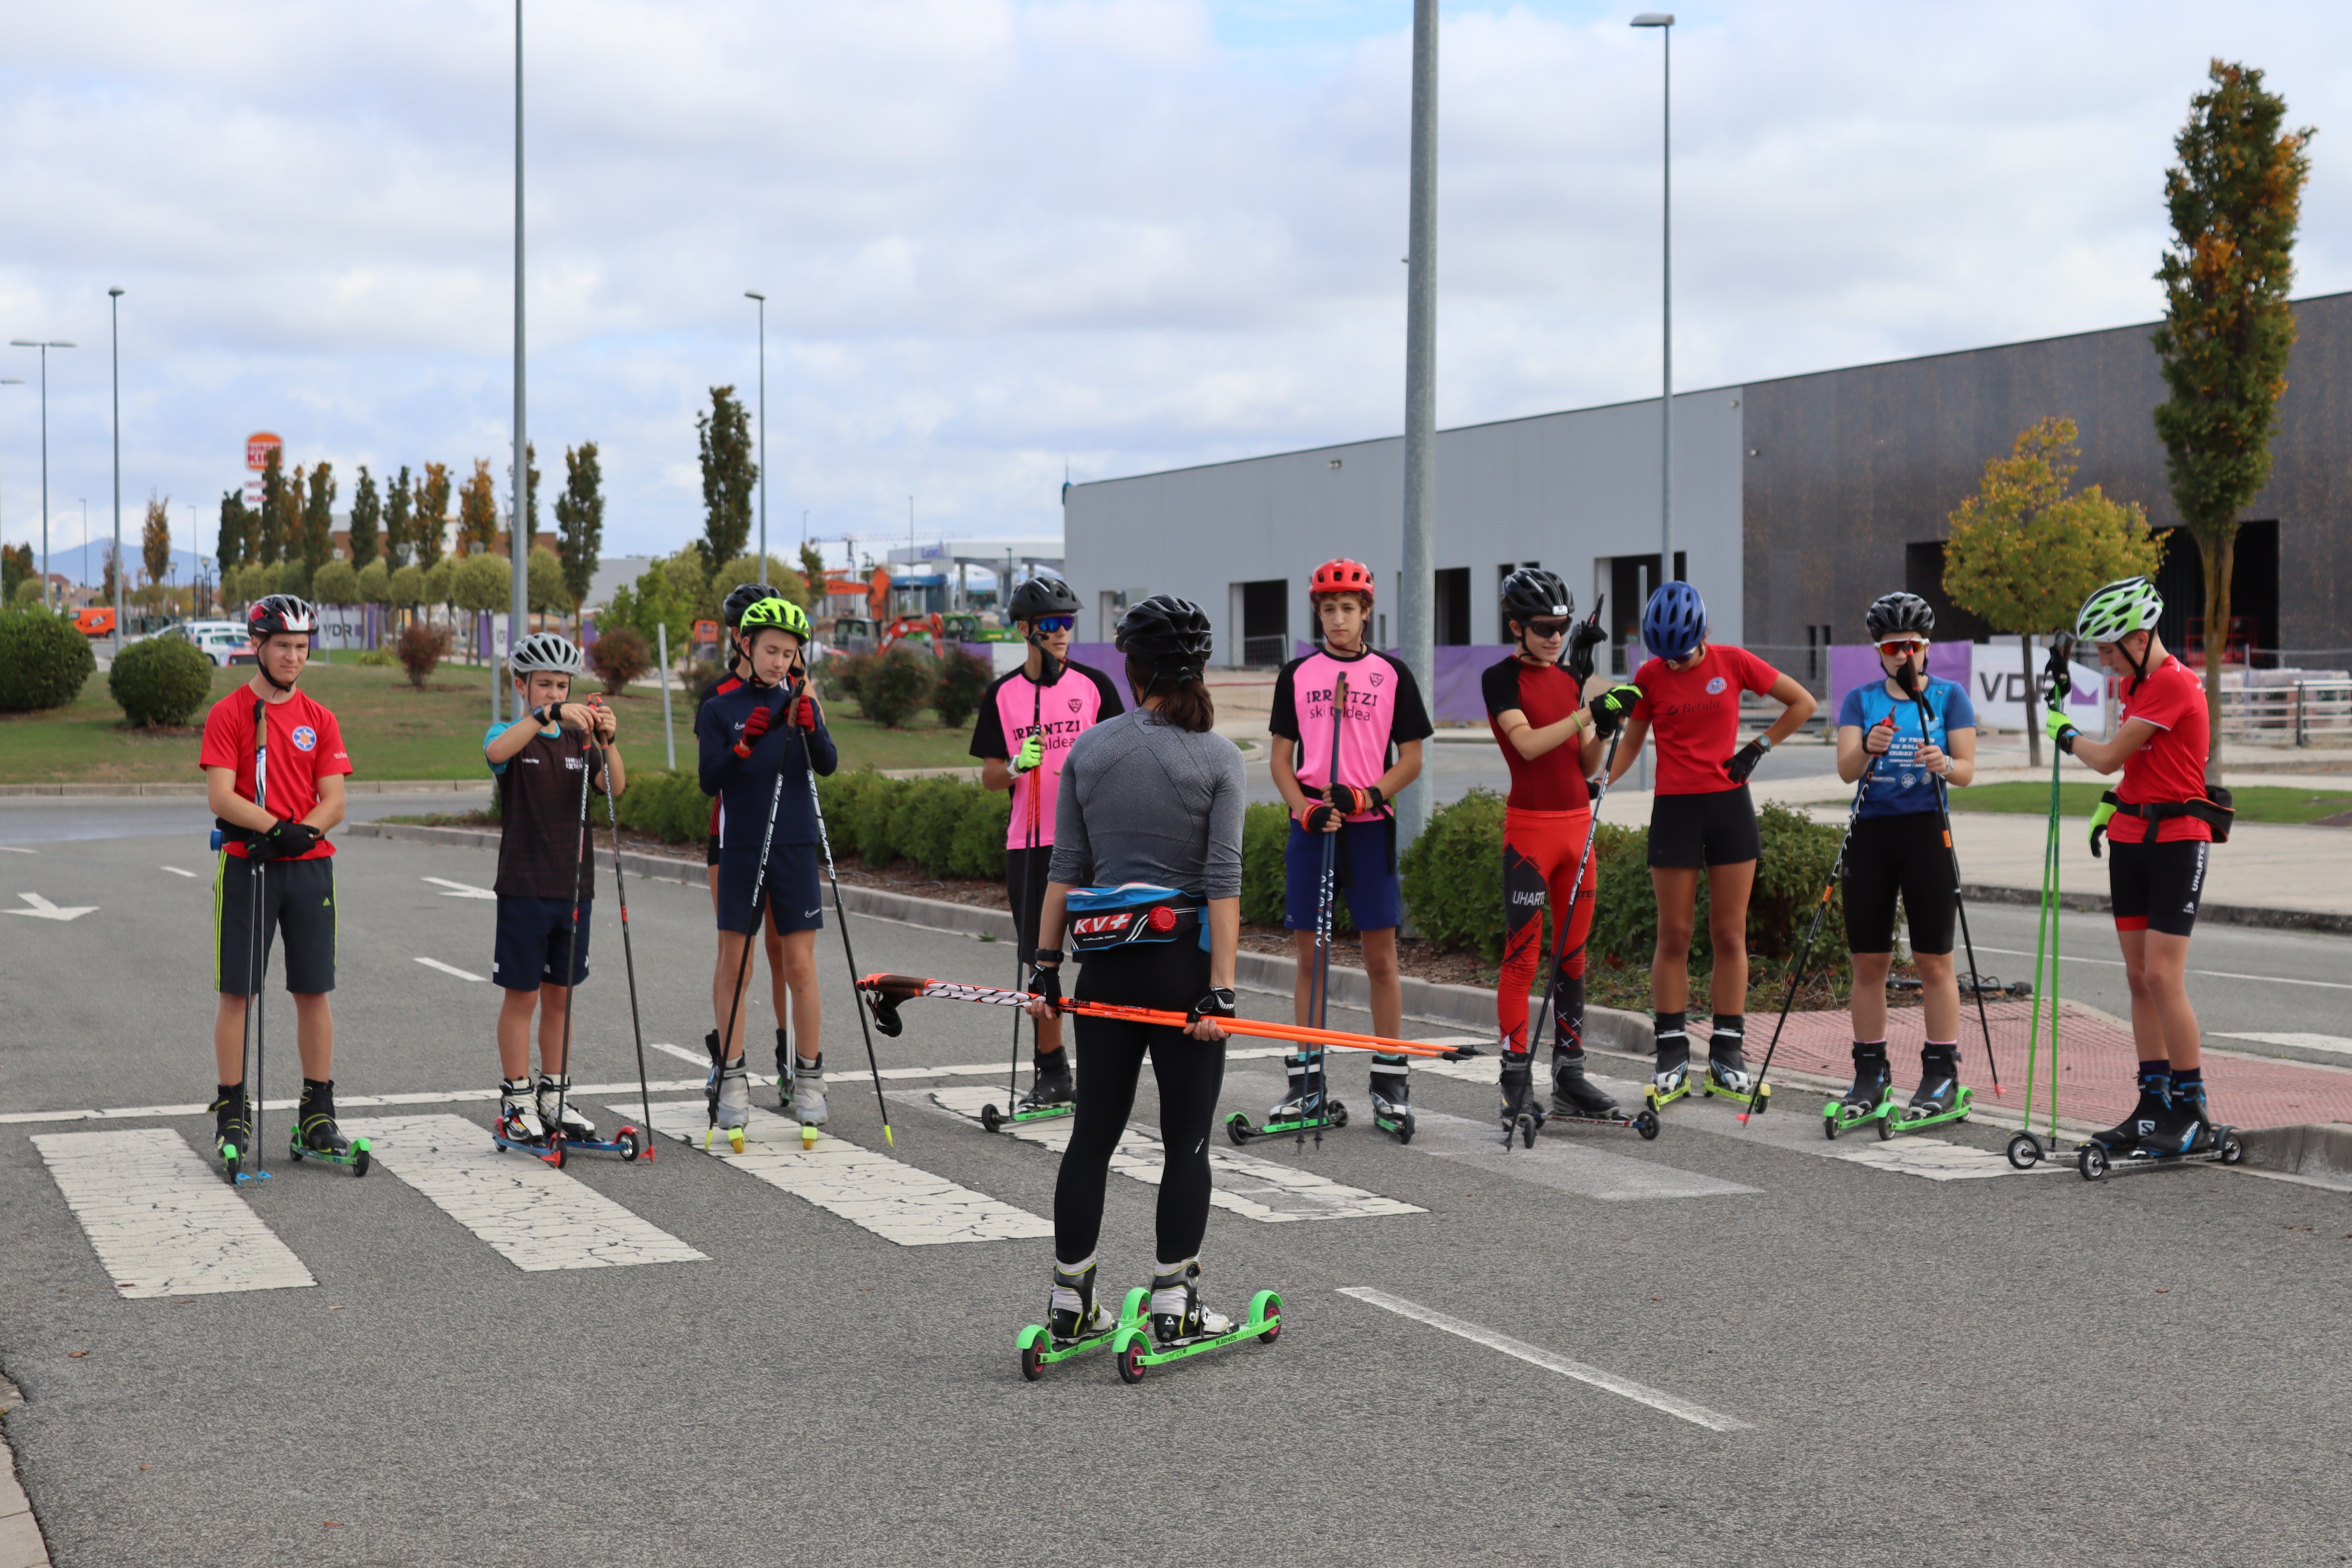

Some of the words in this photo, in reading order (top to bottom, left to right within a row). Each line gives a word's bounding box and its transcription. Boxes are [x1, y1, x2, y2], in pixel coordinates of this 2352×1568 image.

[1310, 705, 1326, 719] ski
[1330, 706, 1370, 721] tldea
[1683, 699, 1720, 713] Betula
